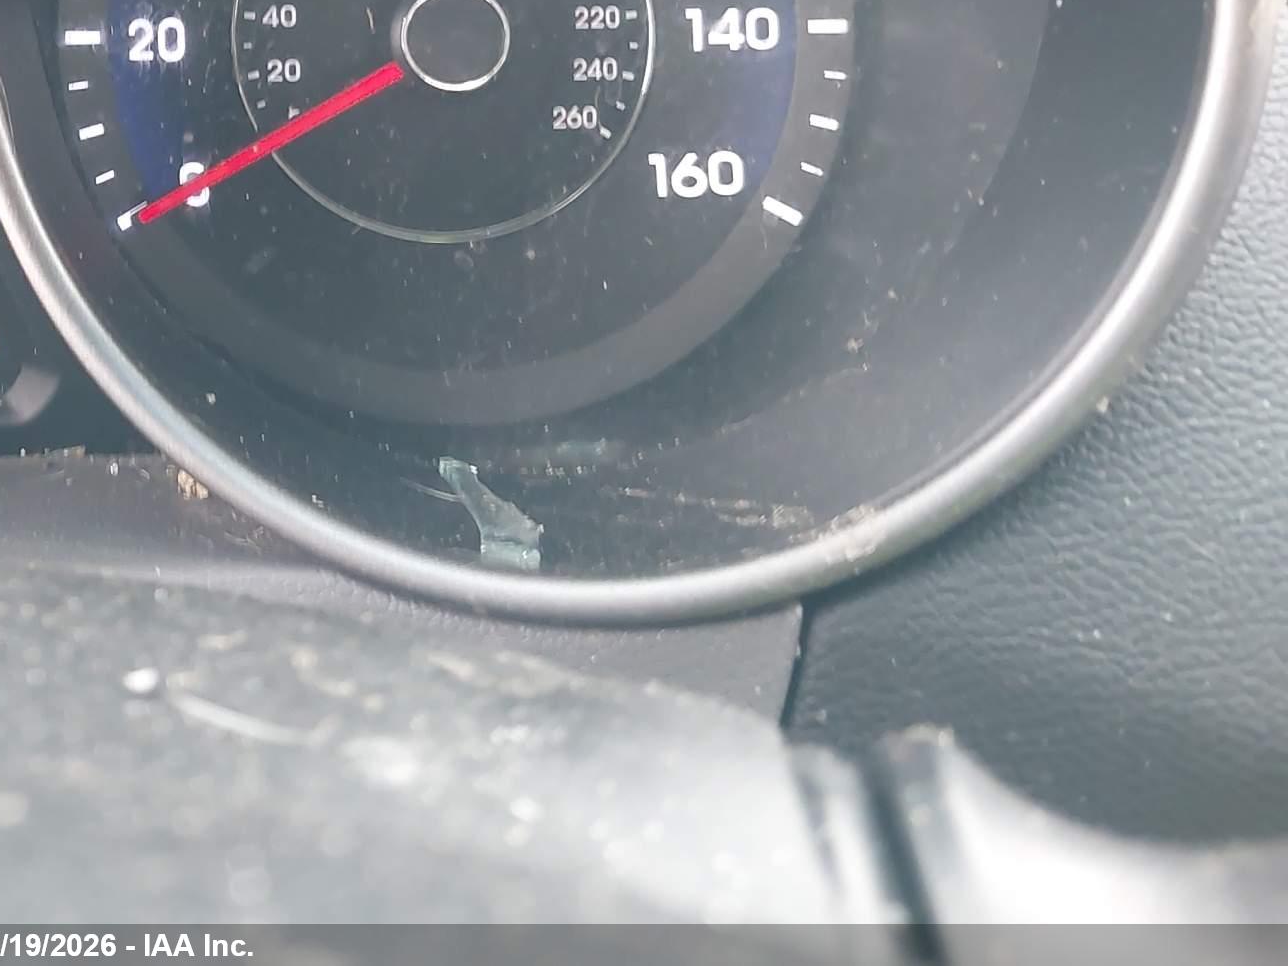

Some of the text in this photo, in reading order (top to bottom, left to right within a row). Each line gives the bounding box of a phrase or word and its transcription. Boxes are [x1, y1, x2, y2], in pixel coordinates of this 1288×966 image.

[262, 4, 297, 28] 40
[574, 5, 621, 30] 220
[128, 15, 186, 63] 20
[685, 7, 780, 53] 140
[267, 58, 301, 83] 20
[573, 56, 618, 81] 240
[552, 105, 598, 130] 260
[648, 150, 745, 198] 160
